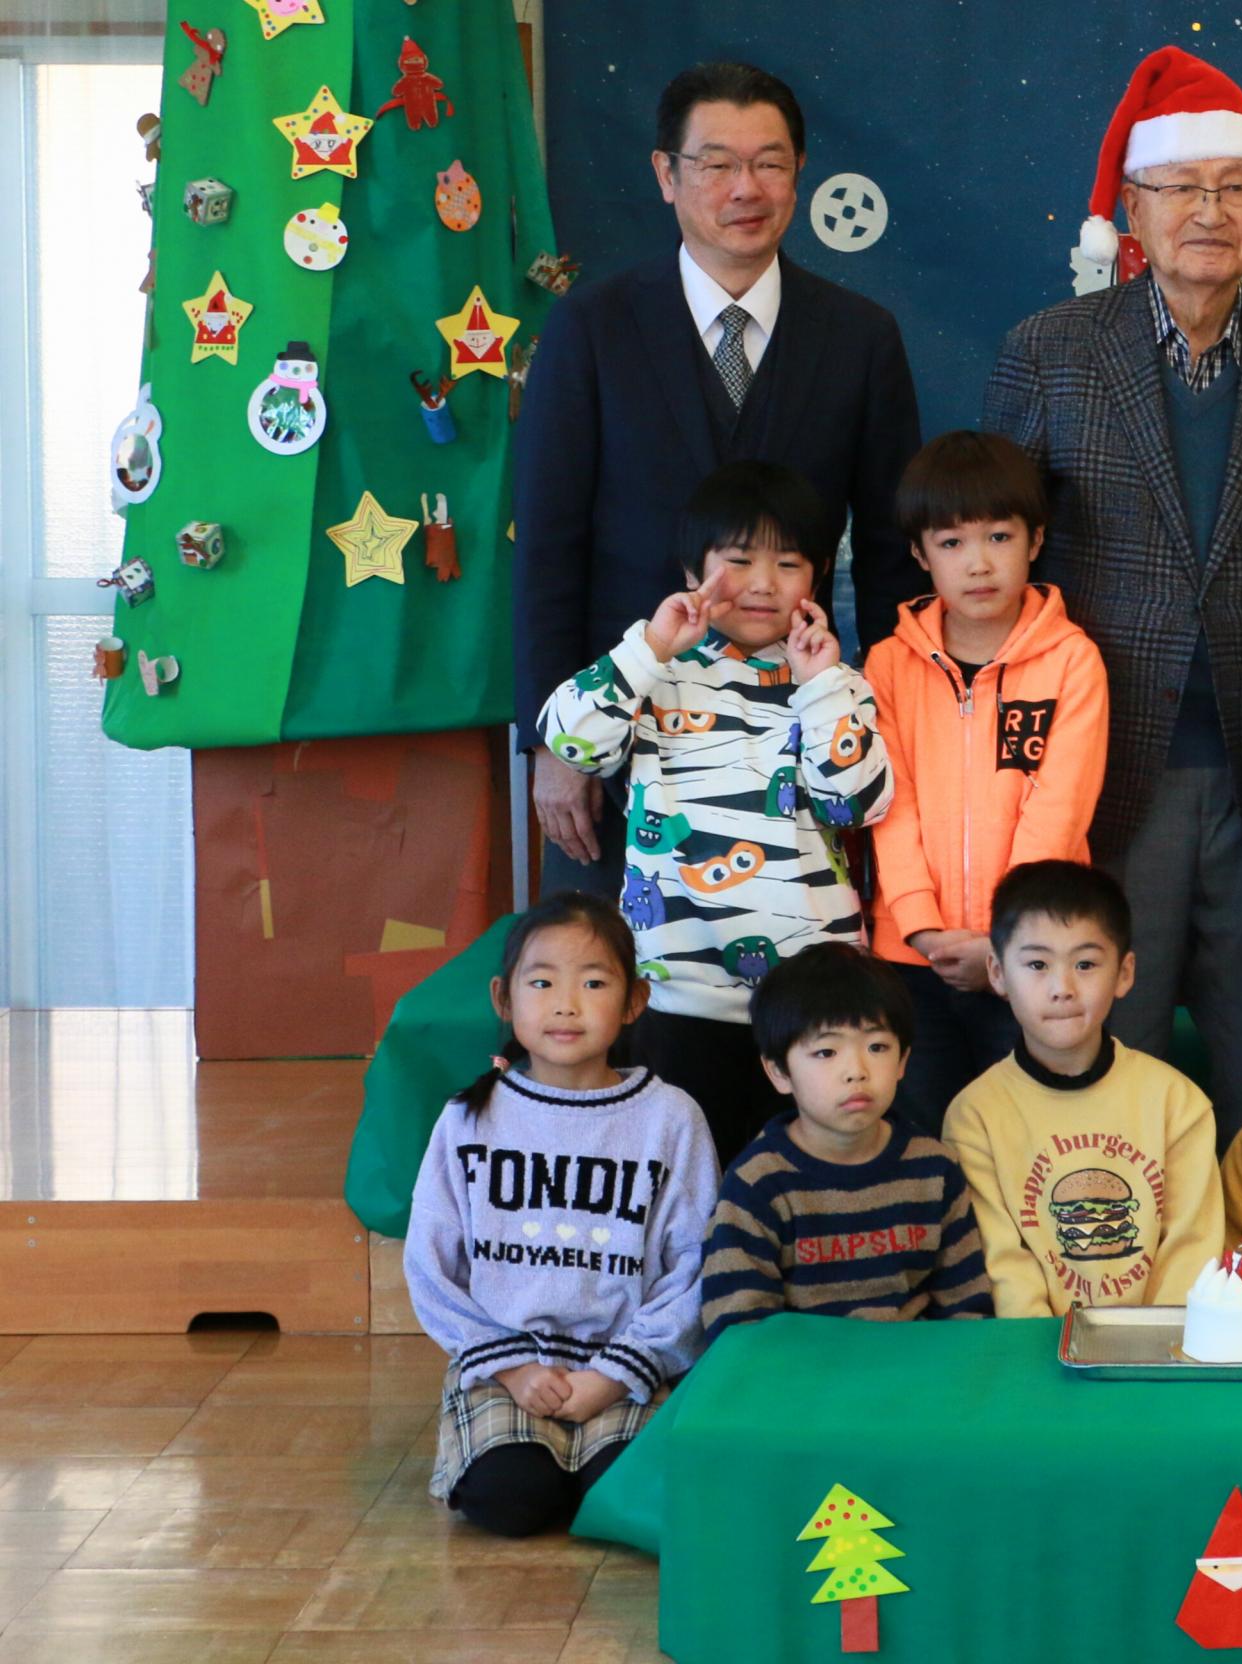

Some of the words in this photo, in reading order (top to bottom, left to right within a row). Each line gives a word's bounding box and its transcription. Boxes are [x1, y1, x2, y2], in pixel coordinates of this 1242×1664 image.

[1020, 1149, 1054, 1228] Happy
[1051, 1132, 1146, 1165] burger
[607, 1253, 645, 1277] TIM
